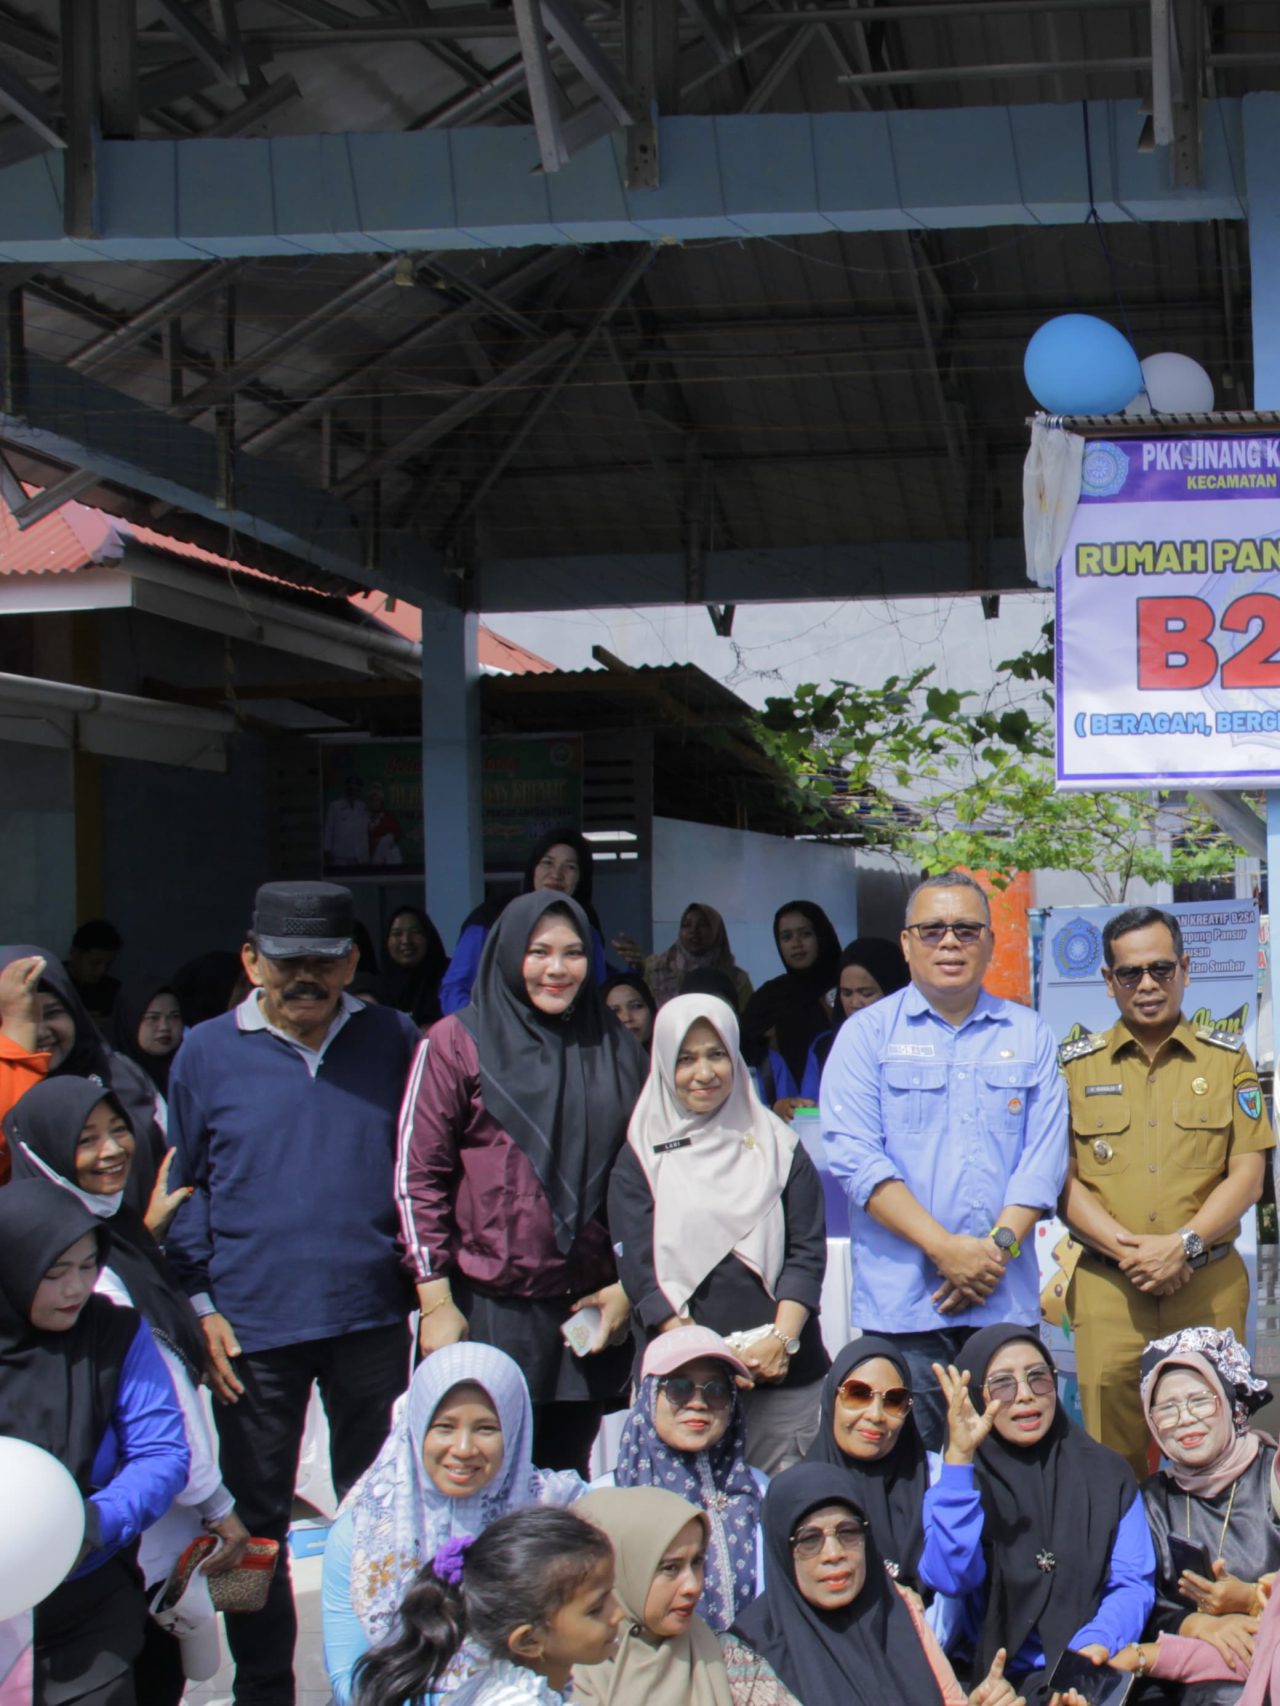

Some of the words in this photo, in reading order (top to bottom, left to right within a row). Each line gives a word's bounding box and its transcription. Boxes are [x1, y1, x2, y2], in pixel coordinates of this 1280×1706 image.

[1142, 442, 1185, 471] PKK
[1186, 439, 1262, 470] JINANG
[1187, 473, 1277, 490] KECAMATAN
[1076, 540, 1208, 577] RUMAH
[1074, 712, 1087, 738] (
[1090, 712, 1213, 737] BERAGAM,
[1190, 912, 1229, 927] KREATIF
[1231, 911, 1256, 925] B2SA
[1213, 928, 1247, 941] Pansur
[1208, 959, 1246, 973] Sumbar
